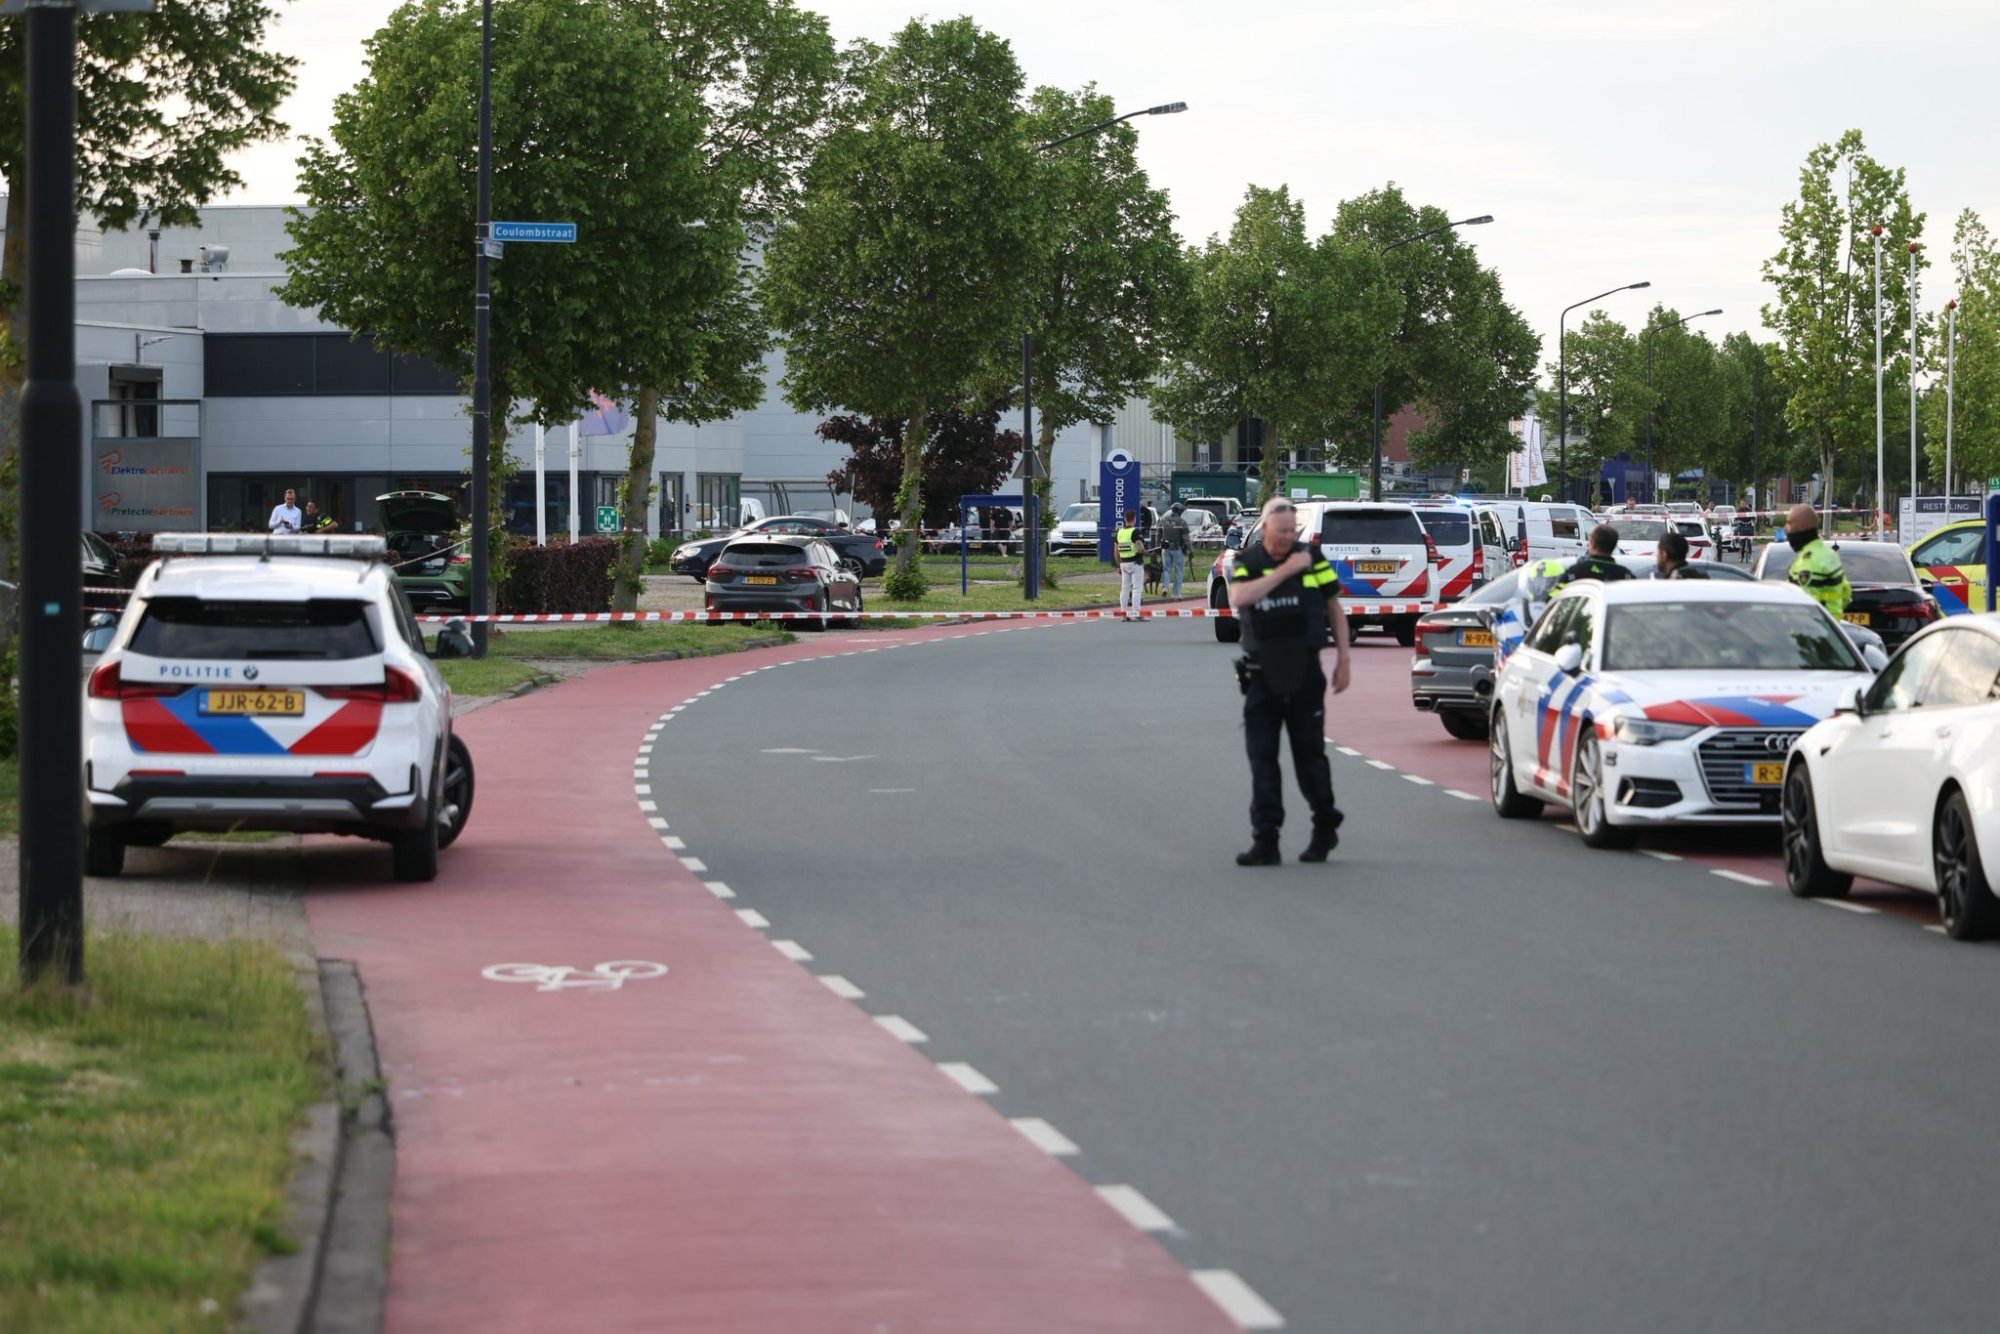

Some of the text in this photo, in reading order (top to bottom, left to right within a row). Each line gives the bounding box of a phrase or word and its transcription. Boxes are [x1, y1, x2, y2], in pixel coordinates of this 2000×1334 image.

[496, 227, 573, 238] Coulombstraat
[1115, 478, 1124, 519] PETFOOD
[1922, 503, 1969, 511] RESTLING
[1843, 613, 1866, 624] 47-P
[1465, 633, 1494, 644] N-974
[160, 666, 233, 678] POLITIE
[216, 694, 295, 711] JJR-62-B
[1758, 766, 1784, 781] R-3
